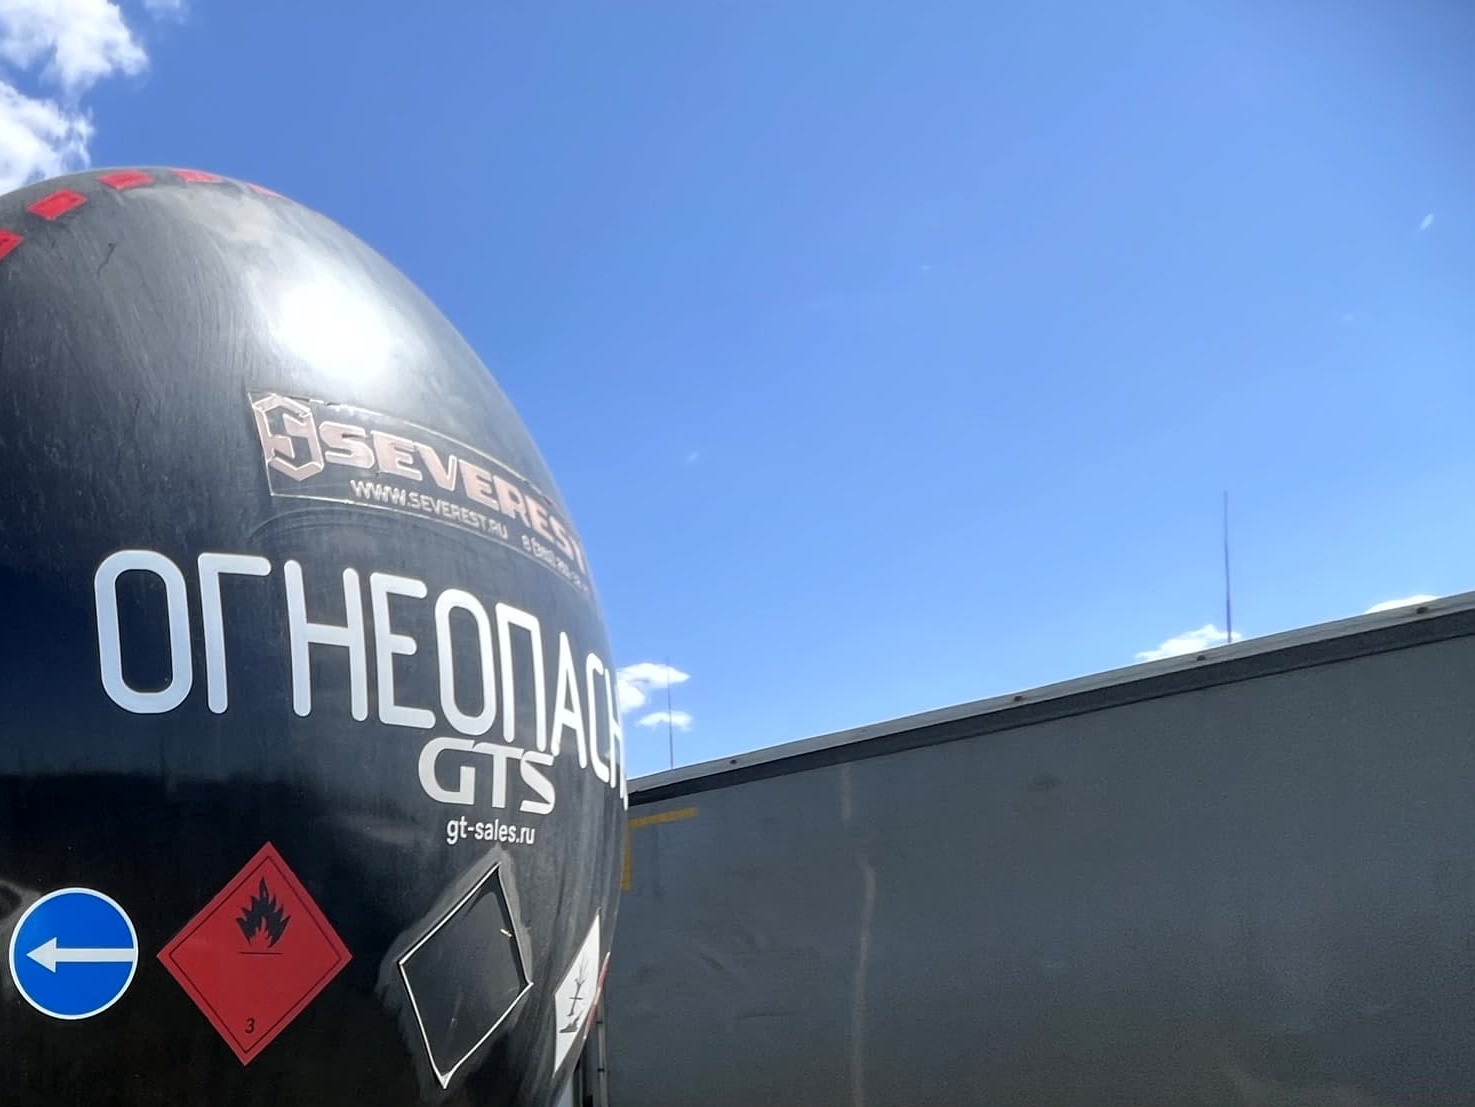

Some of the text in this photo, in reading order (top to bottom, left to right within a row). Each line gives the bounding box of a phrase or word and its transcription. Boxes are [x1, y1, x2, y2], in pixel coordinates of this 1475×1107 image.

[94, 549, 629, 811] ОГНЕОПАСН
[418, 736, 555, 815] GTS
[445, 815, 536, 845] gt-sales.ru
[245, 1017, 255, 1034] 3
